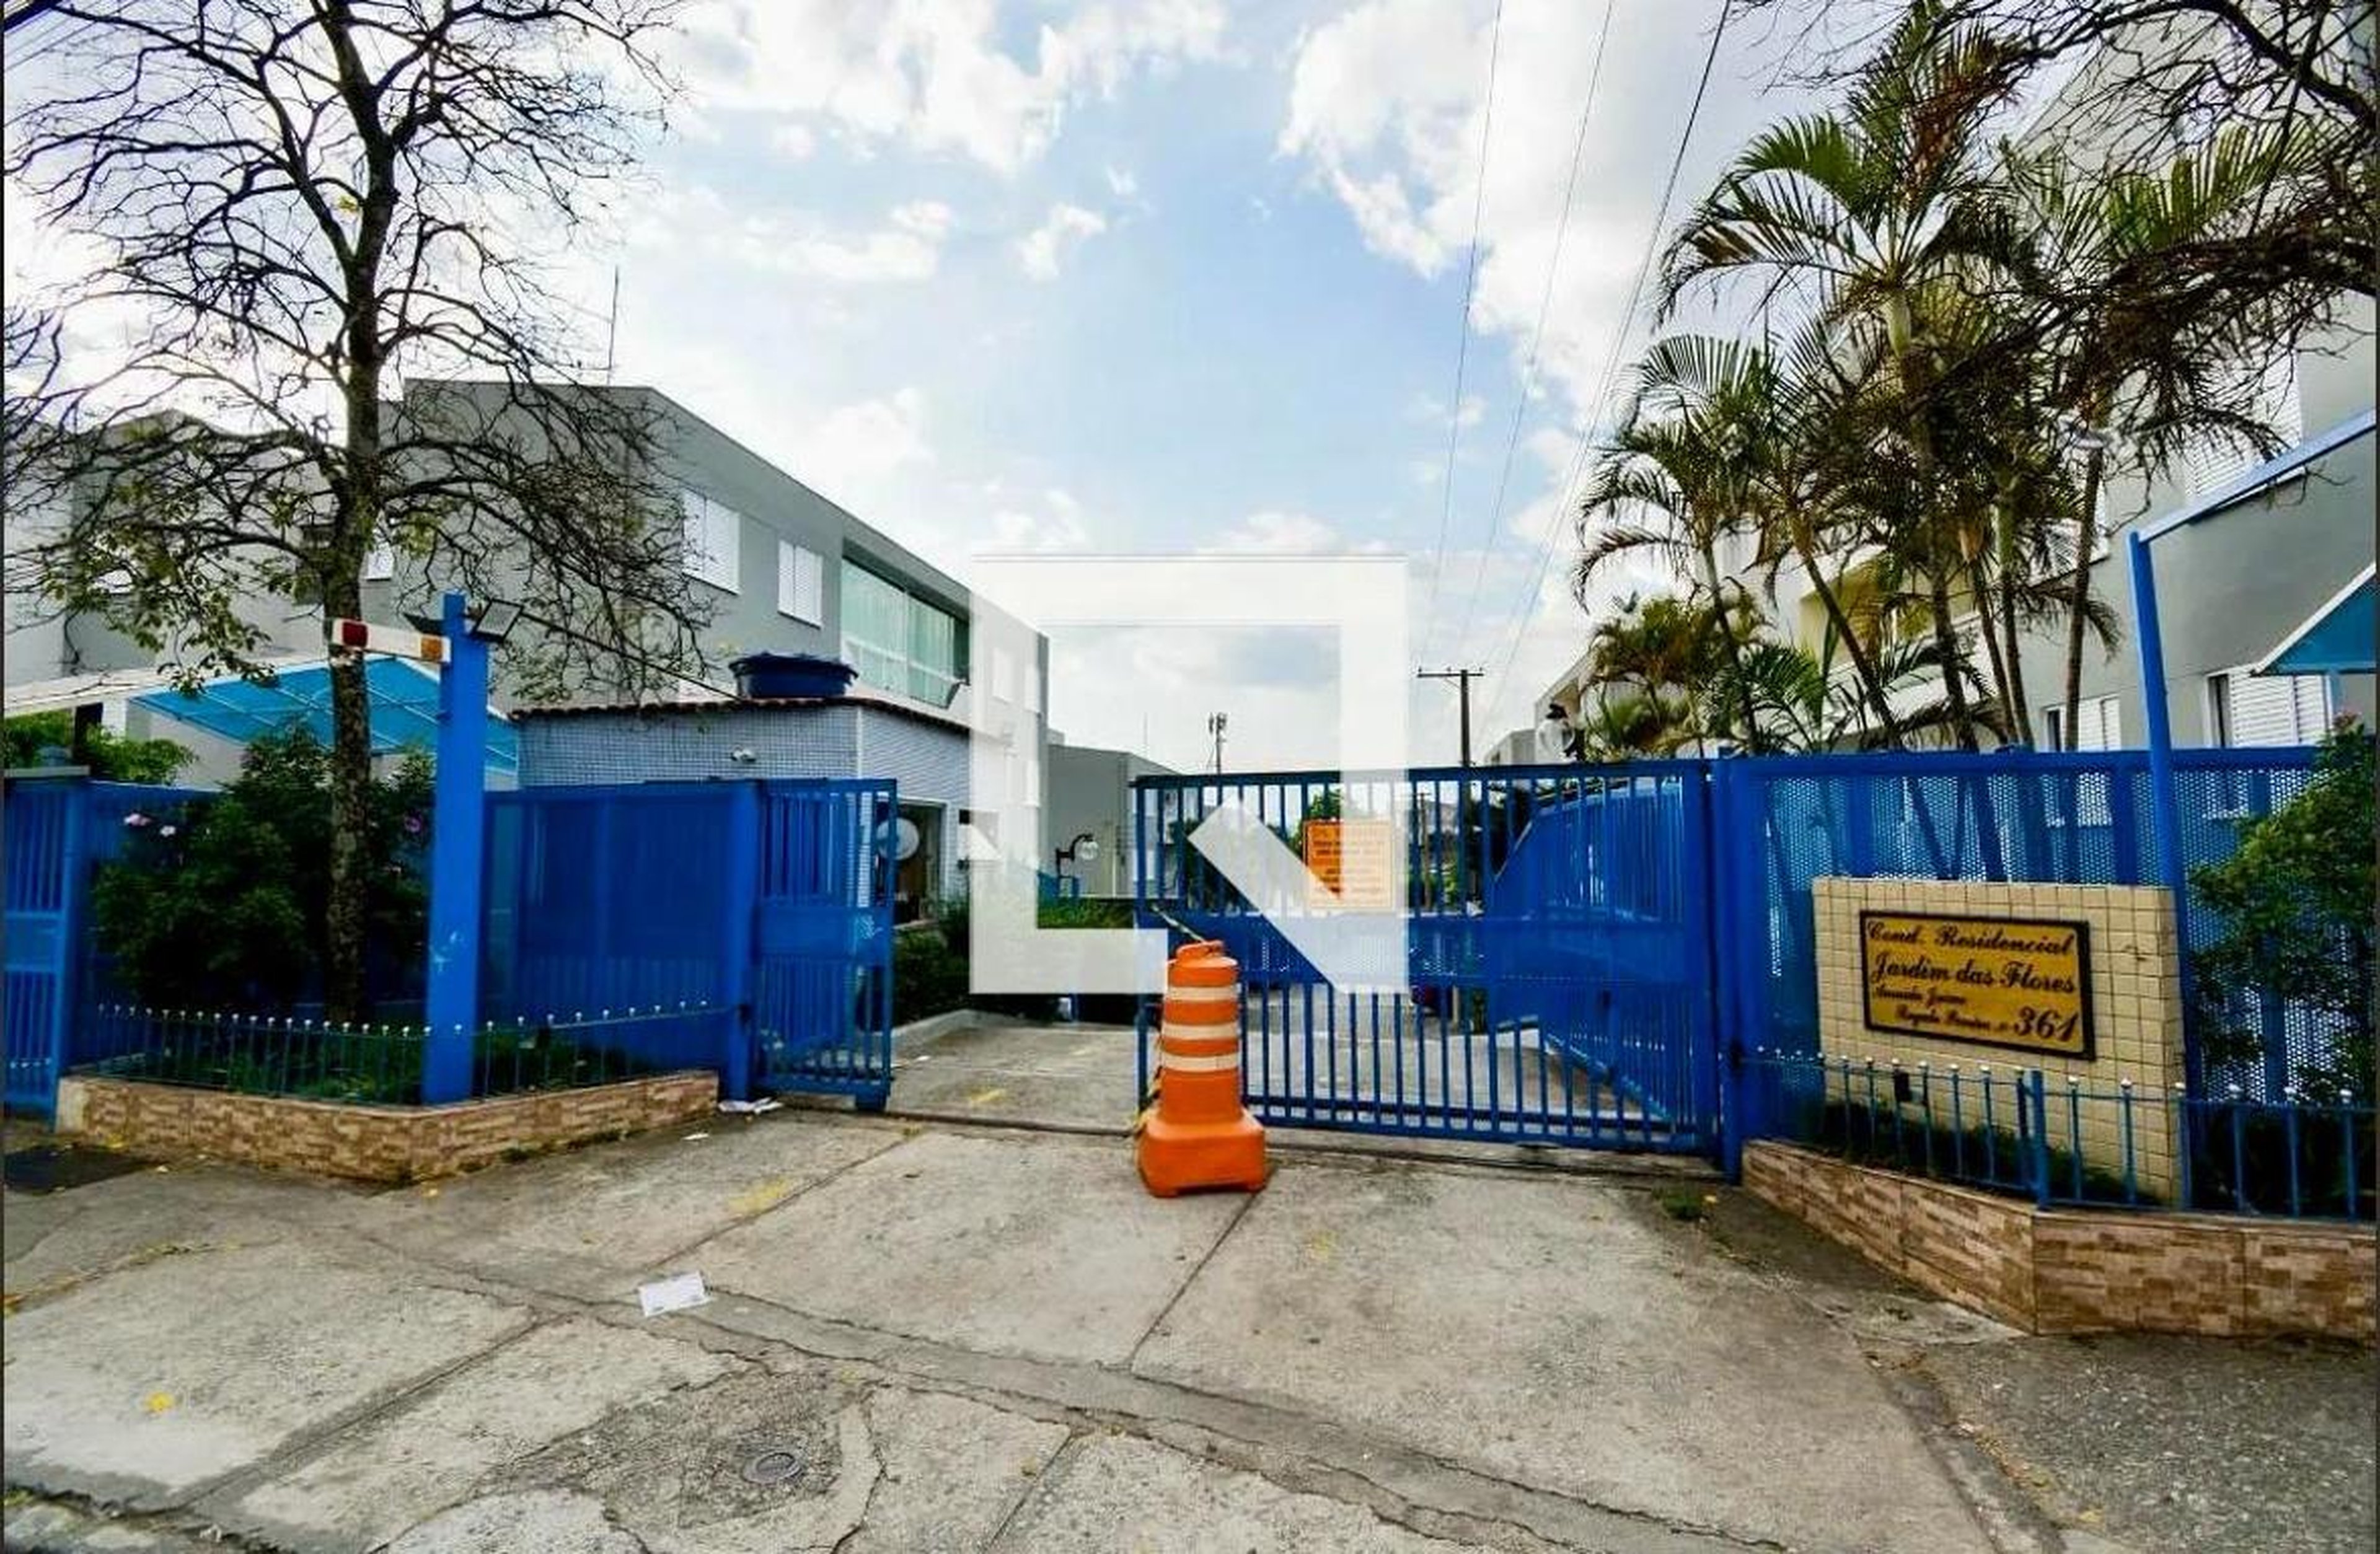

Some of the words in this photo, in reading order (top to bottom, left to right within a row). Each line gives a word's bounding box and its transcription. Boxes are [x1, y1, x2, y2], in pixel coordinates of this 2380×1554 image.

[1934, 924, 2074, 955] Residencial
[1871, 951, 1950, 984] Jardim
[1955, 959, 1994, 985] das
[1999, 960, 2074, 993] Flores
[2014, 1006, 2079, 1042] 361
